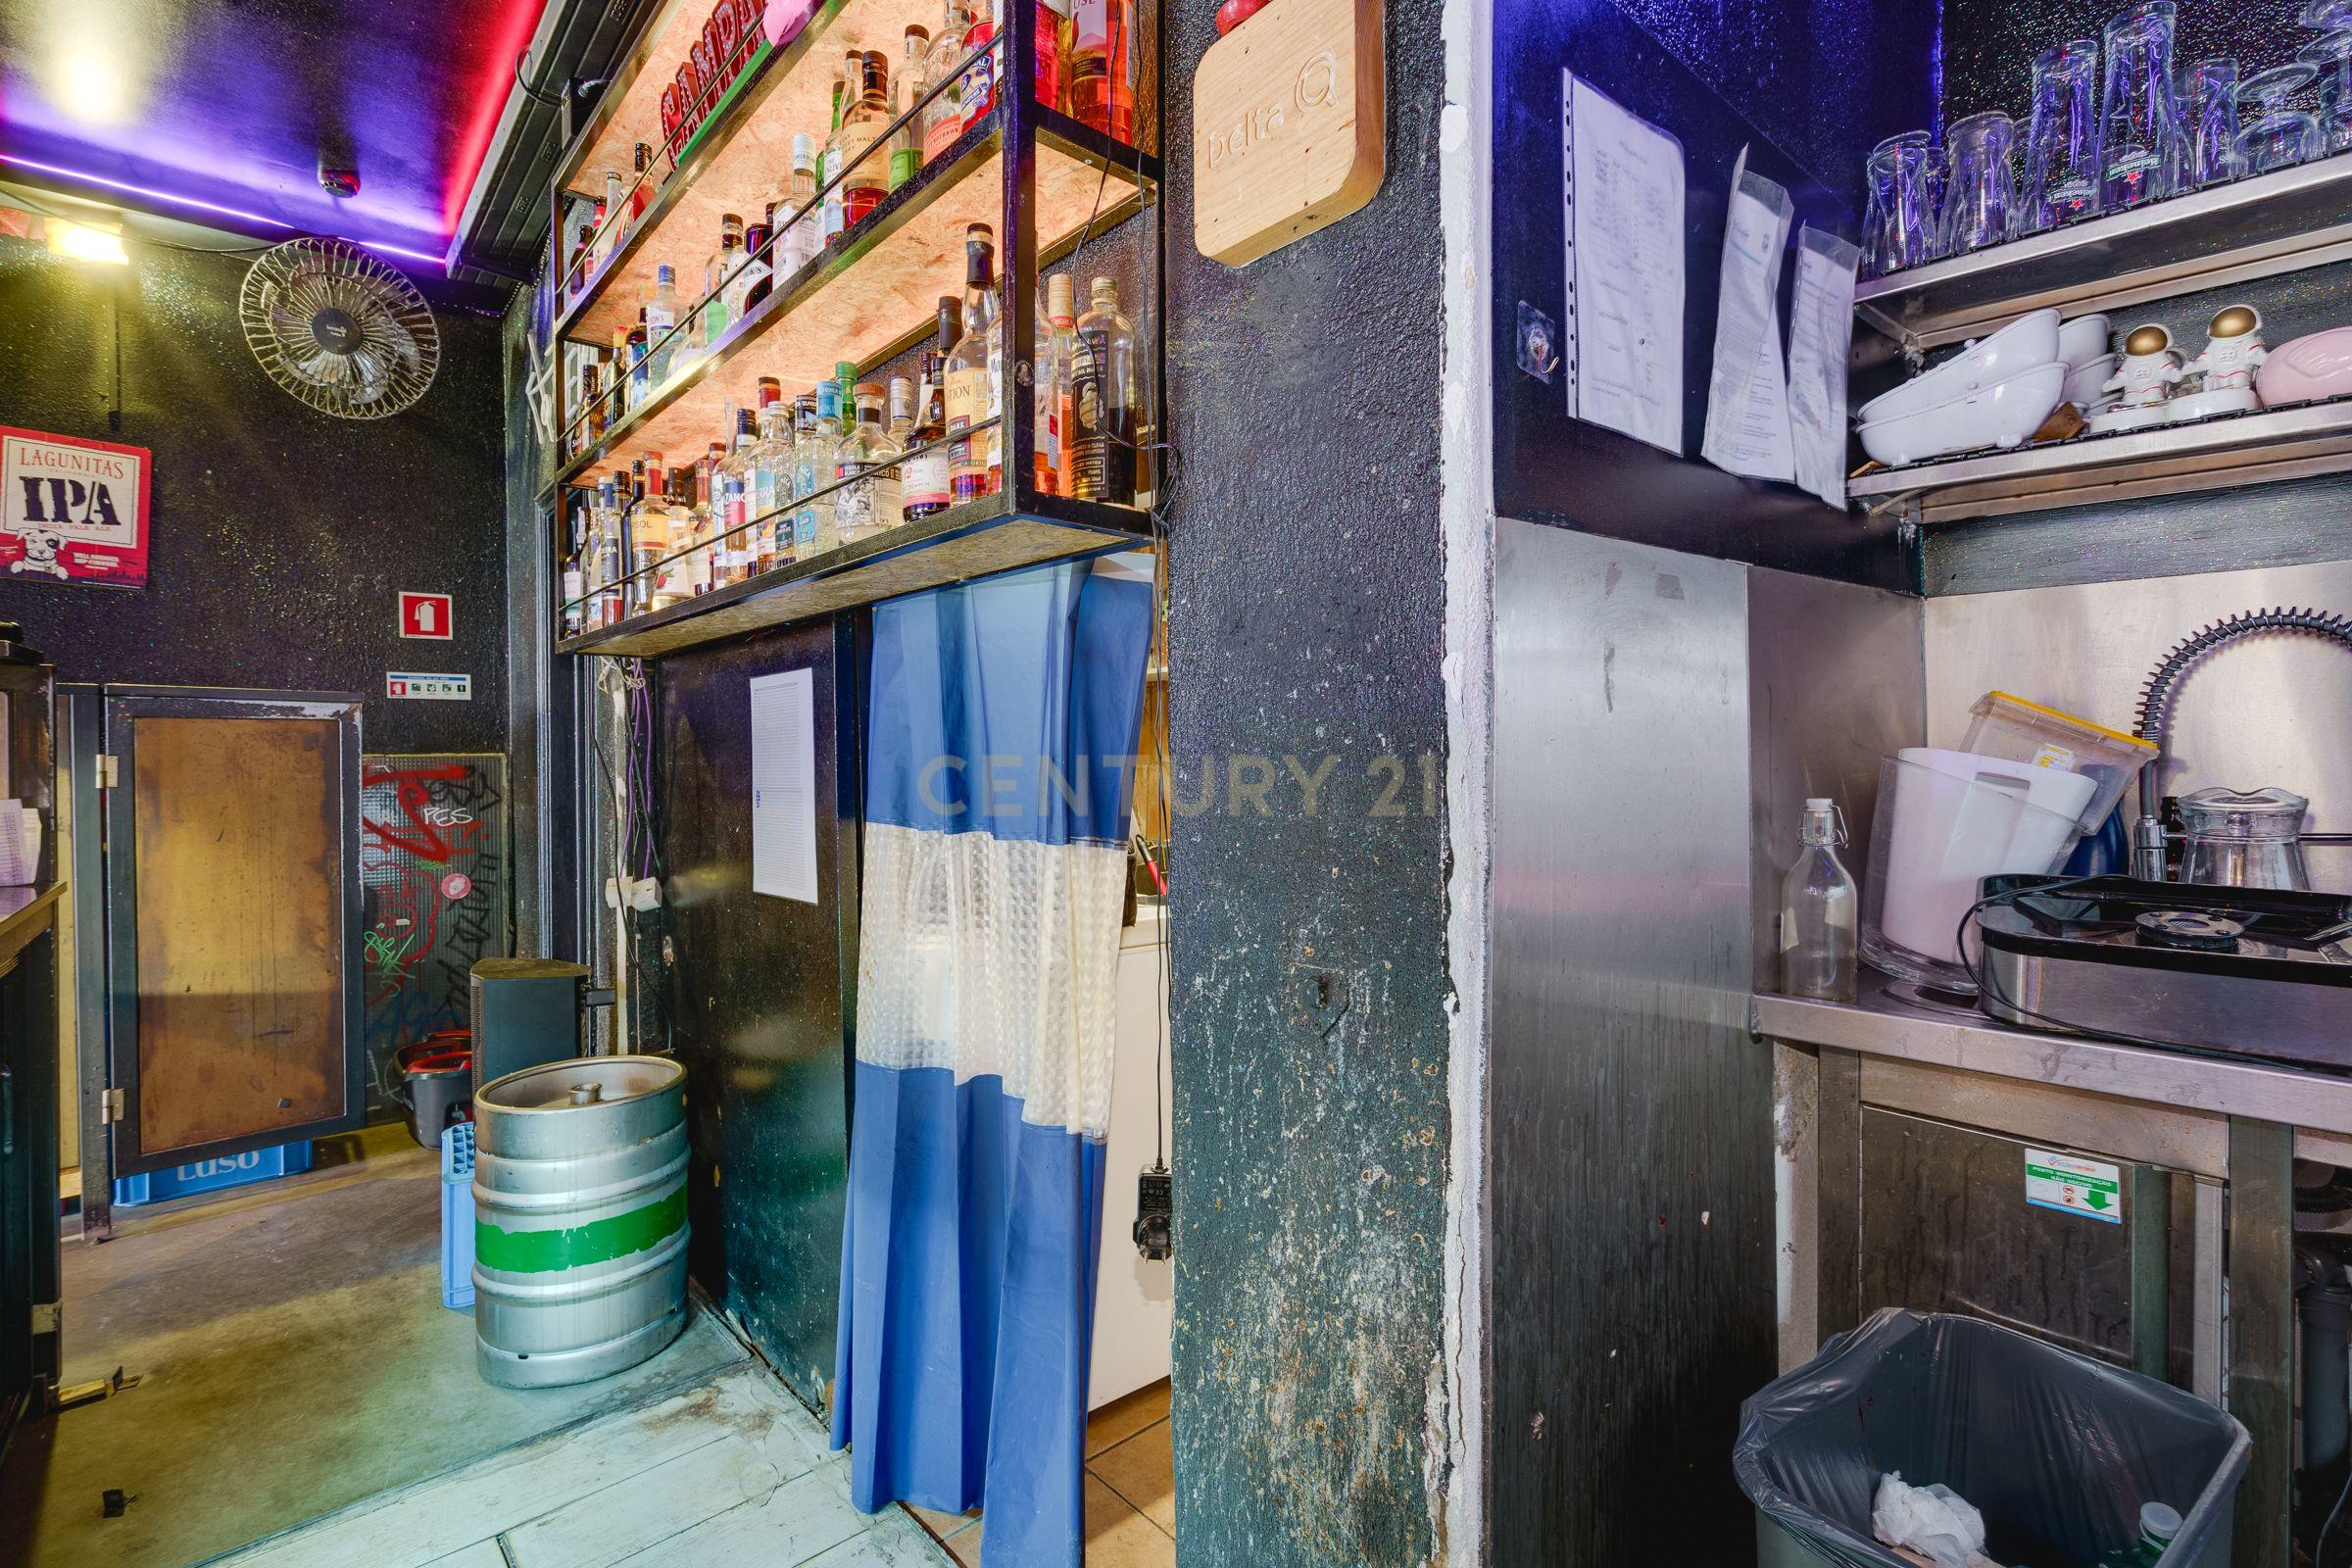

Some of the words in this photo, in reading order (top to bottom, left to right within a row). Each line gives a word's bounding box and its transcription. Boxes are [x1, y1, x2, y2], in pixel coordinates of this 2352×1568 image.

[1207, 102, 1285, 170] Delta
[1294, 49, 1338, 114] Q
[2109, 157, 2159, 175] Heineken
[19, 447, 124, 479] LAGUNITAS
[20, 476, 122, 525] IPA
[422, 807, 473, 828] PES
